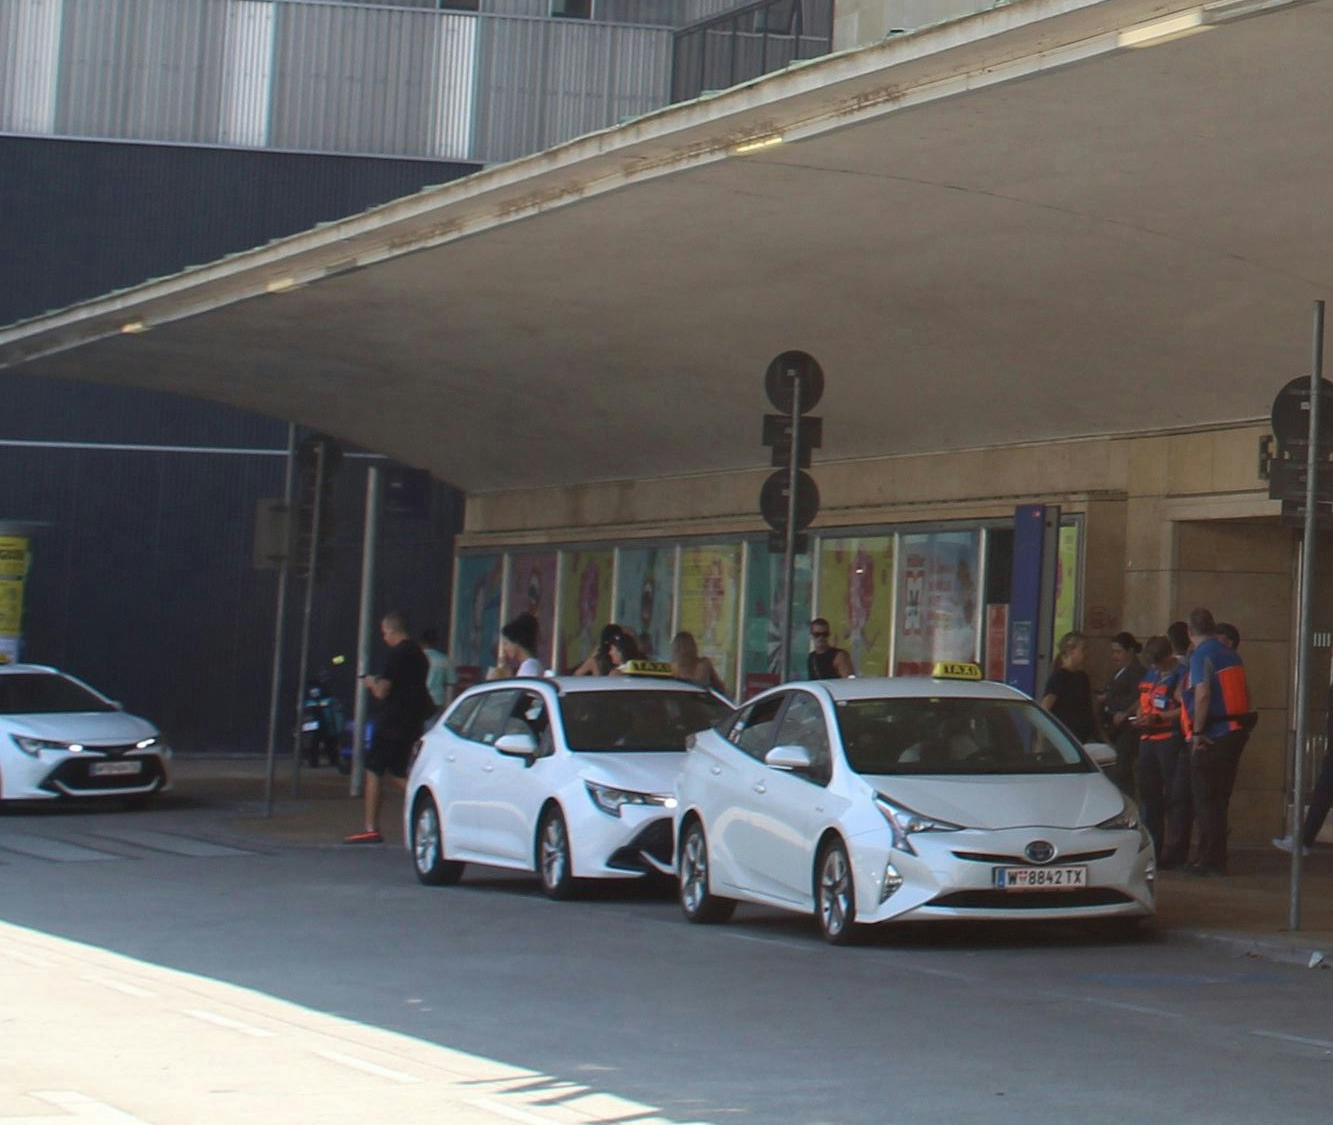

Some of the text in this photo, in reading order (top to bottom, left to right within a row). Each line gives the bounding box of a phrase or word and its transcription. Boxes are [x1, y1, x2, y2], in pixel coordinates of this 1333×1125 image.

[944, 664, 978, 675] TAXI
[1008, 869, 1083, 885] W 8842 TX
